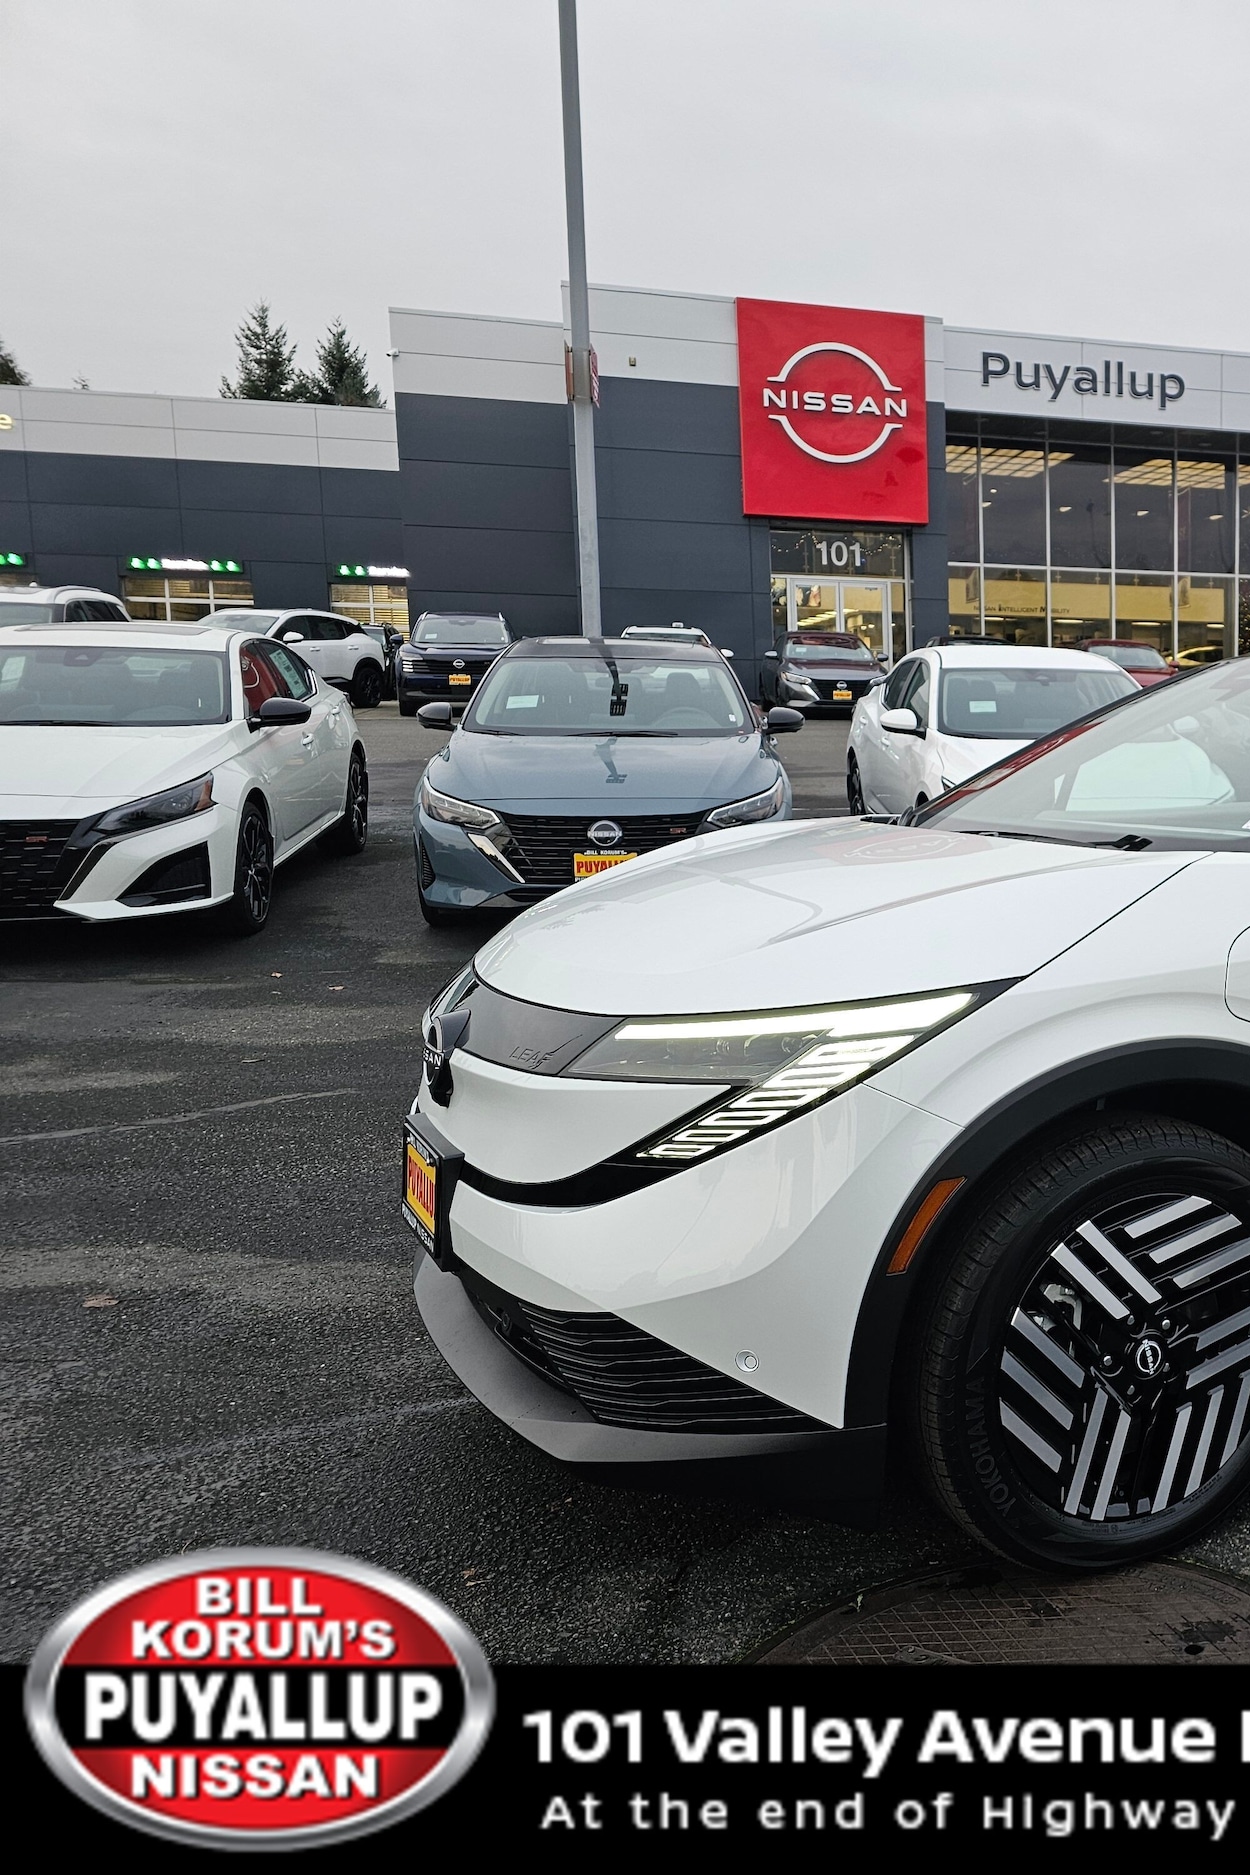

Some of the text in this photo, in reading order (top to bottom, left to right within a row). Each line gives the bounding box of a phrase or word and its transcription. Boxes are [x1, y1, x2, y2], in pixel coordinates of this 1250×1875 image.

[981, 351, 1186, 410] Puyallup
[763, 386, 907, 419] NISSAN
[816, 540, 862, 567] 101
[587, 830, 622, 838] NISSAN
[508, 1045, 555, 1070] LEAF
[1141, 1338, 1155, 1376] NISSAN
[965, 1376, 1017, 1518] YOKOHAMA
